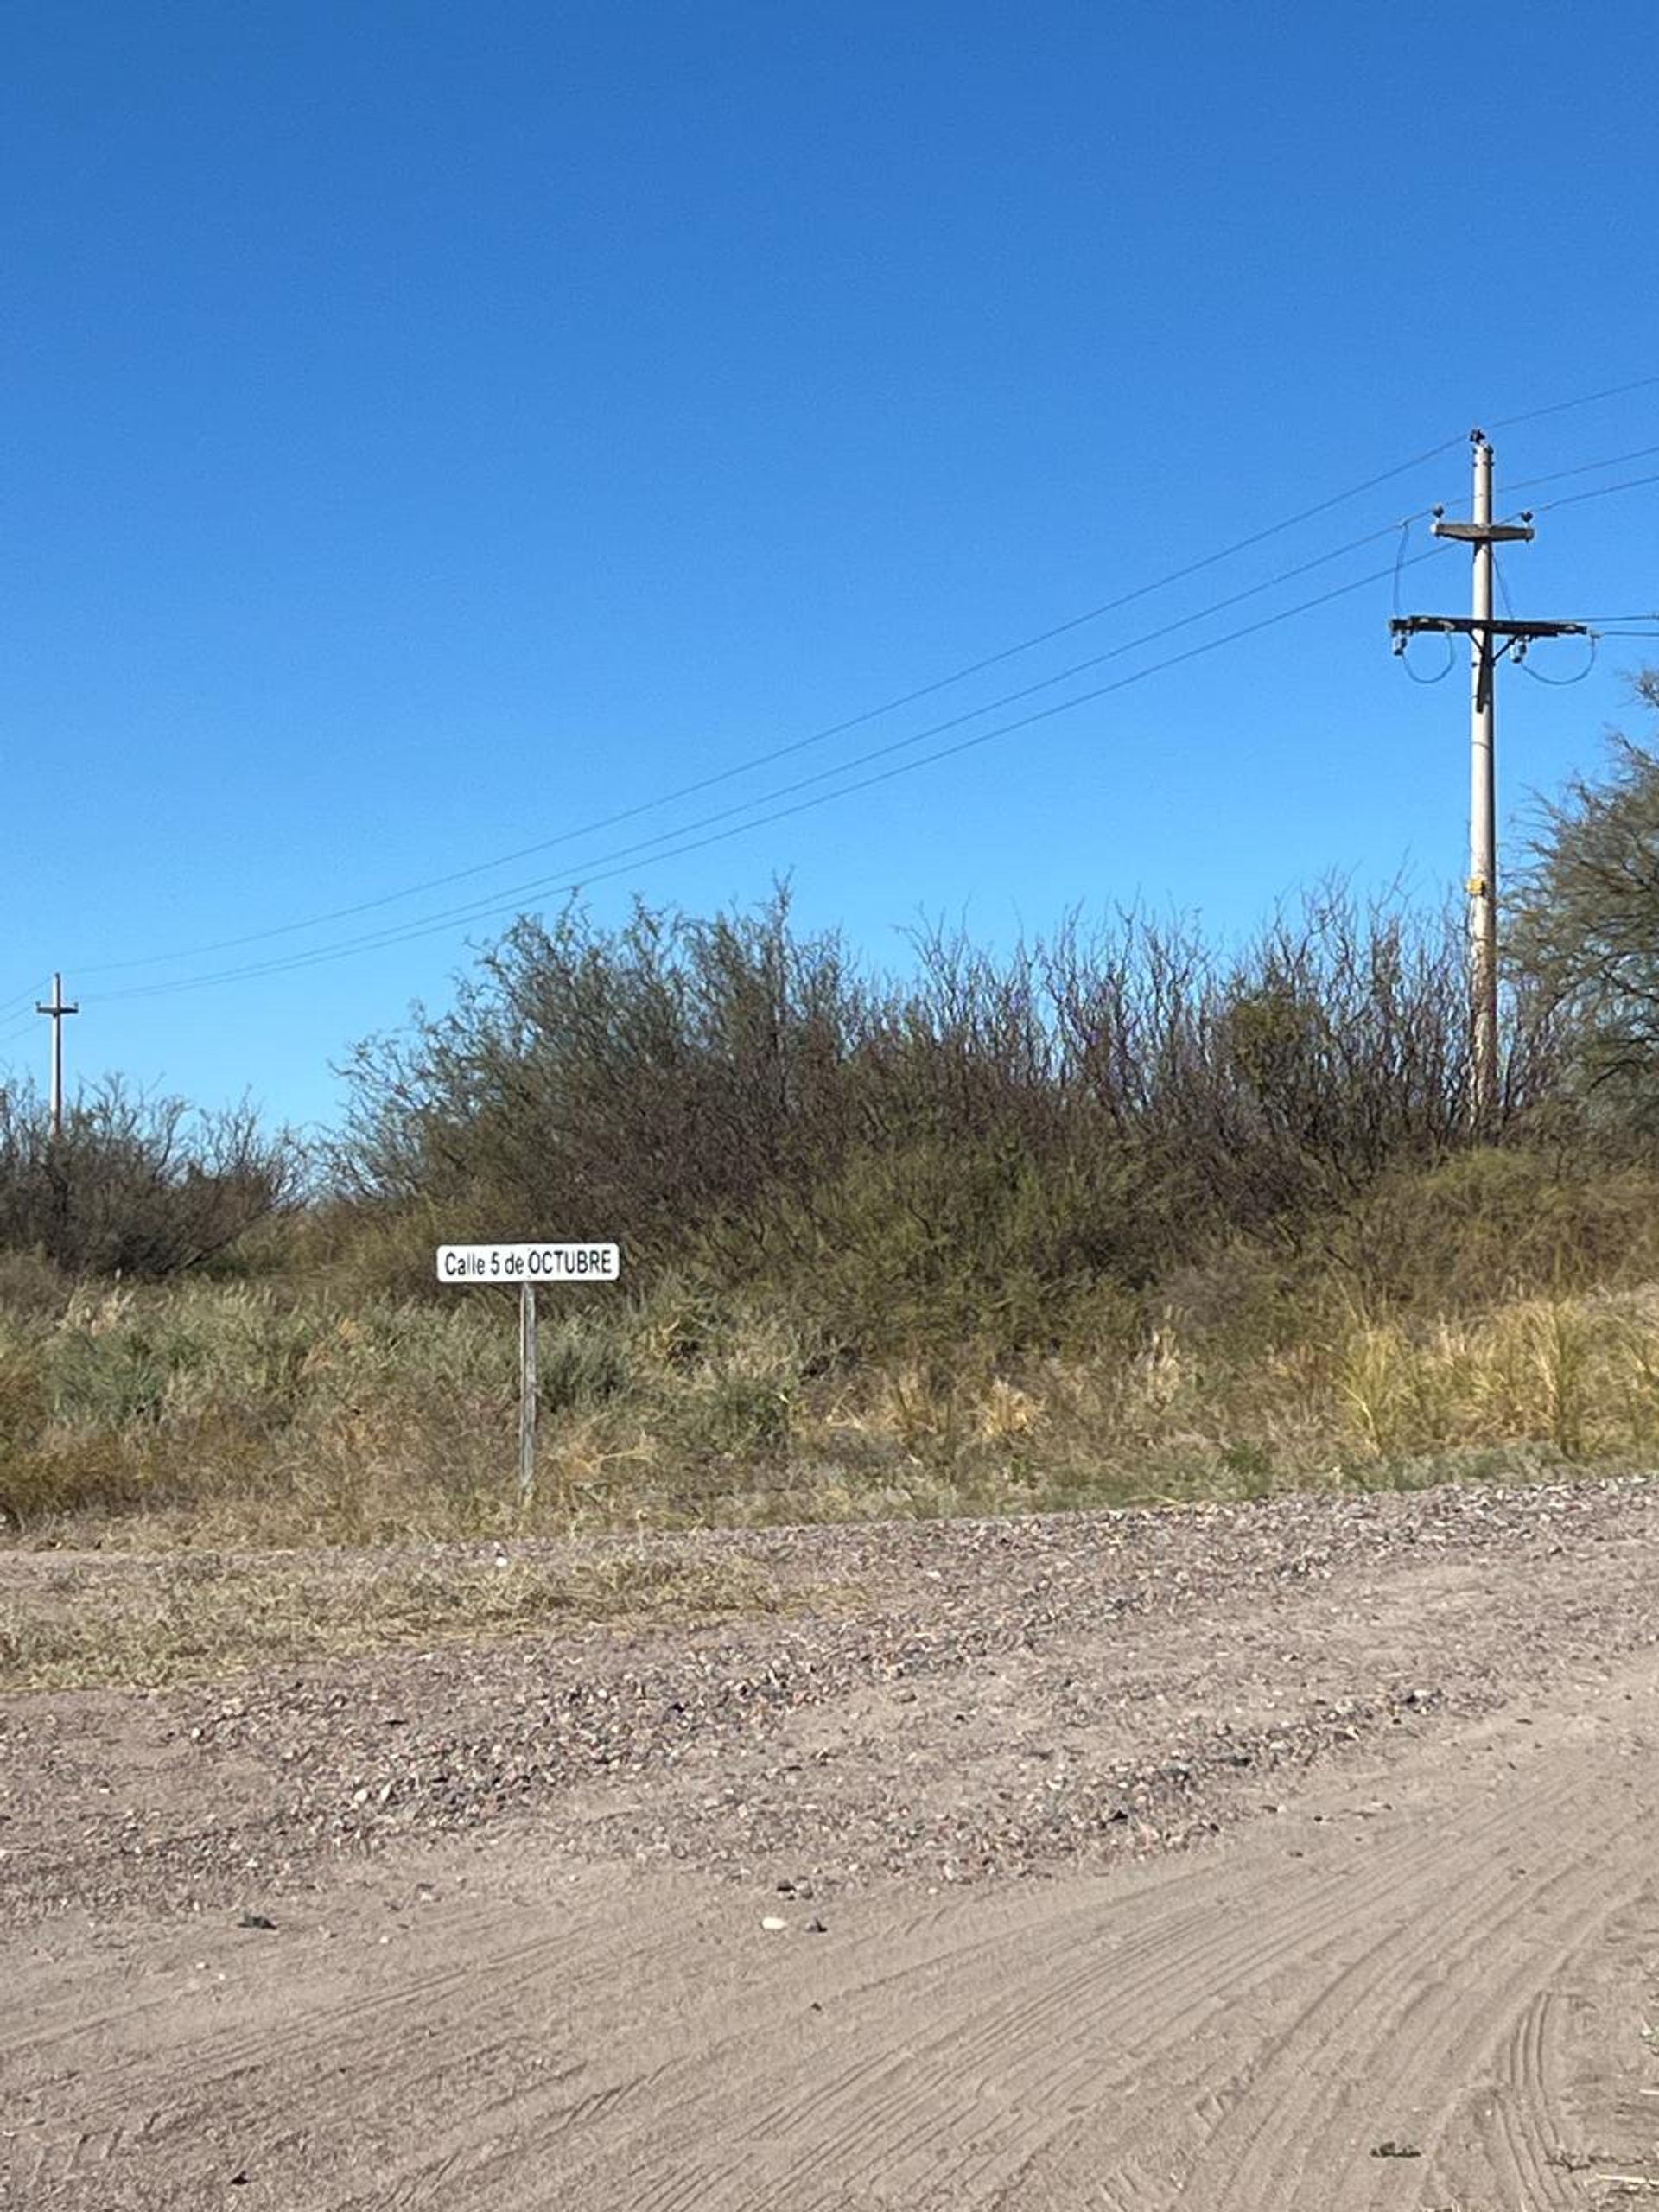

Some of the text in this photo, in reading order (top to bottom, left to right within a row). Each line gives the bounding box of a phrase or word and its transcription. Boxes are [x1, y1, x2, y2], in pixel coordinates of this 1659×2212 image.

[445, 1249, 612, 1275] Calle 5 de OCTUBRE
